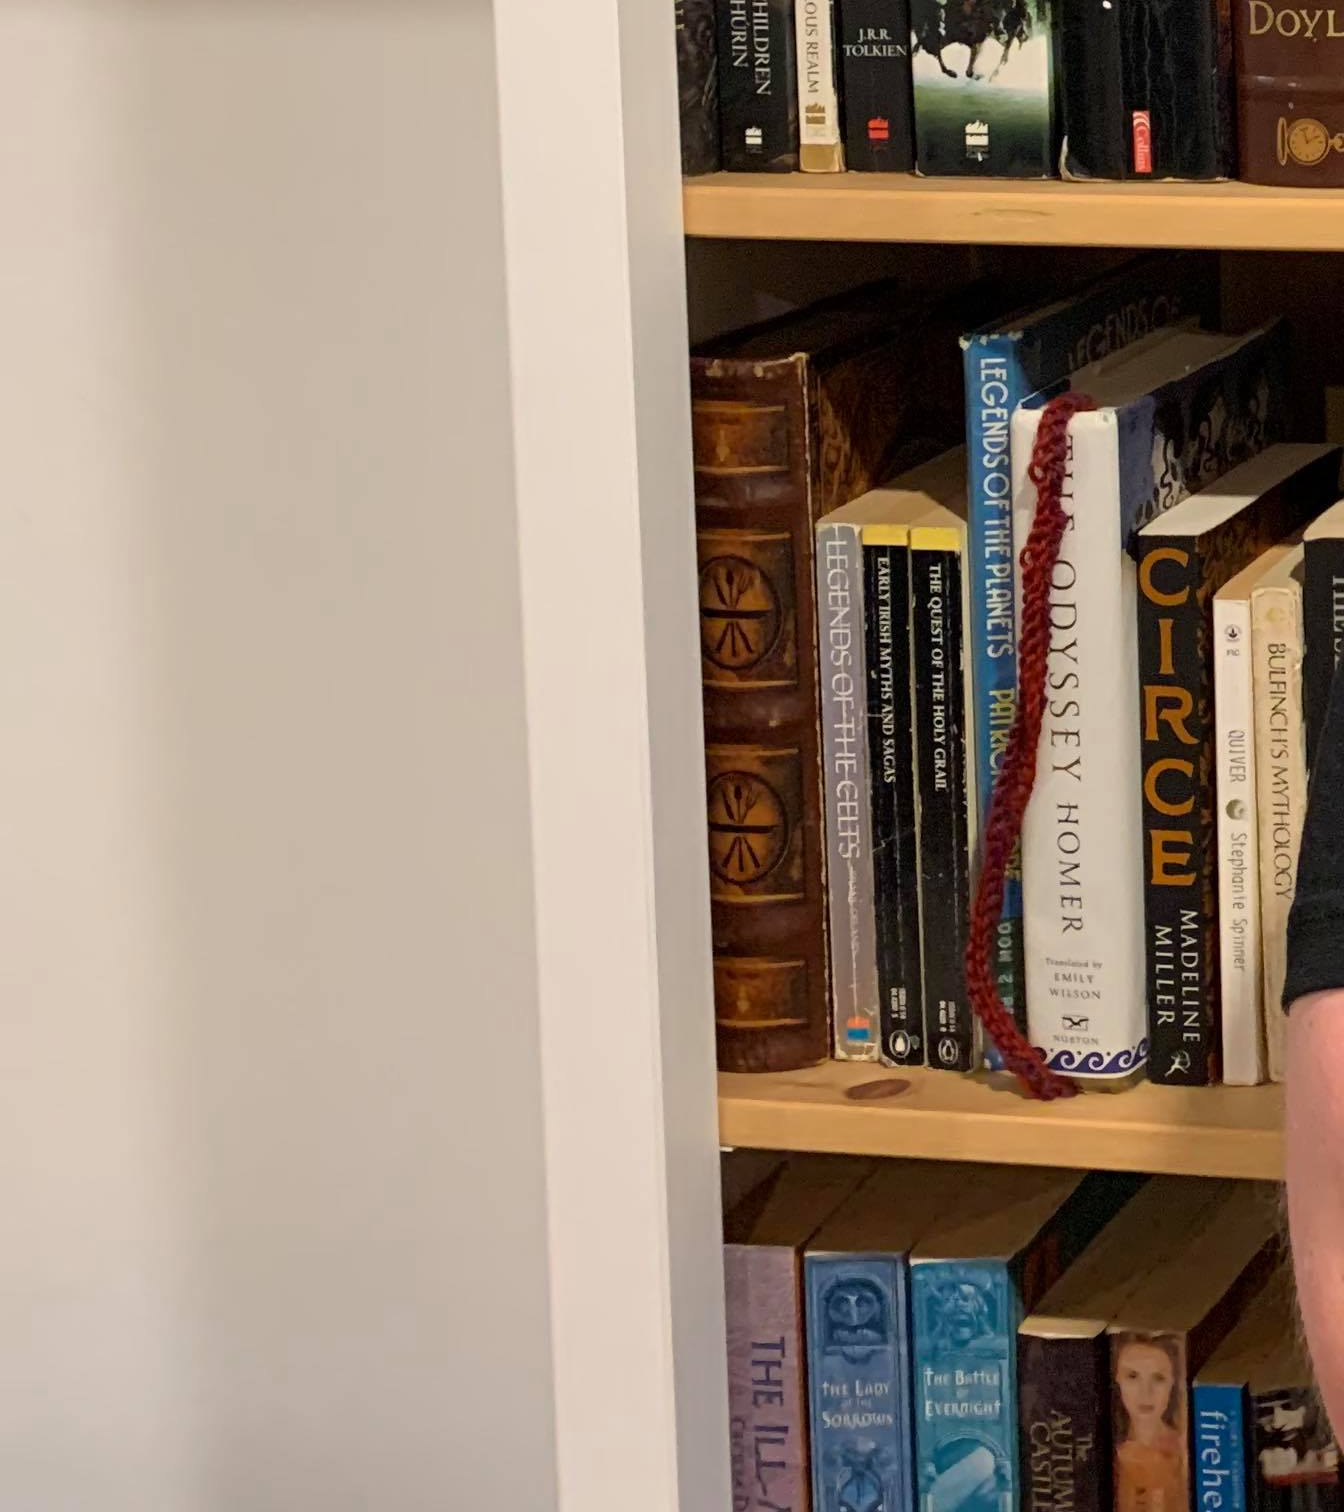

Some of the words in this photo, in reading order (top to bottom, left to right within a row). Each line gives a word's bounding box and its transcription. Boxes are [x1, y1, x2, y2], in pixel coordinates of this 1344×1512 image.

[805, 41, 820, 94] REALM
[842, 43, 908, 58] TOLKIEN
[979, 356, 1009, 469] LEGENDS
[982, 471, 1010, 512] OF
[984, 514, 1011, 557] THE
[825, 539, 853, 667] LEGENDS
[877, 557, 890, 602] EARLY
[929, 563, 943, 594] THE
[878, 606, 892, 644] IRISH
[927, 596, 944, 645] QUEST
[984, 560, 1015, 659] PLANETS
[879, 646, 893, 699] MYTHS
[930, 648, 945, 668] OF
[1049, 559, 1082, 783] ODYSSEY
[830, 672, 854, 709] OF
[931, 672, 946, 702] THE
[1267, 641, 1290, 759] BULFINCH'S
[881, 703, 894, 735] AND
[932, 705, 946, 744] HOLY
[1139, 546, 1200, 887] CIRCE
[833, 719, 857, 775] THE
[882, 738, 896, 783] SAGAS
[934, 747, 948, 791] GRAIL
[1227, 729, 1247, 784] QUIVER
[834, 780, 860, 859] CELTS
[1270, 765, 1293, 900] MYTHOLOGY
[1055, 802, 1084, 934] HOMER
[1229, 832, 1248, 911] Stephanie
[1231, 917, 1248, 973] Spinner
[1049, 987, 1102, 1000] WILSON
[1054, 972, 1095, 984] EMILY
[1154, 924, 1176, 1026] MILLER
[1179, 908, 1201, 1043] MADELINE
[751, 1336, 786, 1408] THE
[822, 1380, 849, 1398] THE
[855, 1379, 889, 1398] LADY
[923, 1366, 950, 1387] THE
